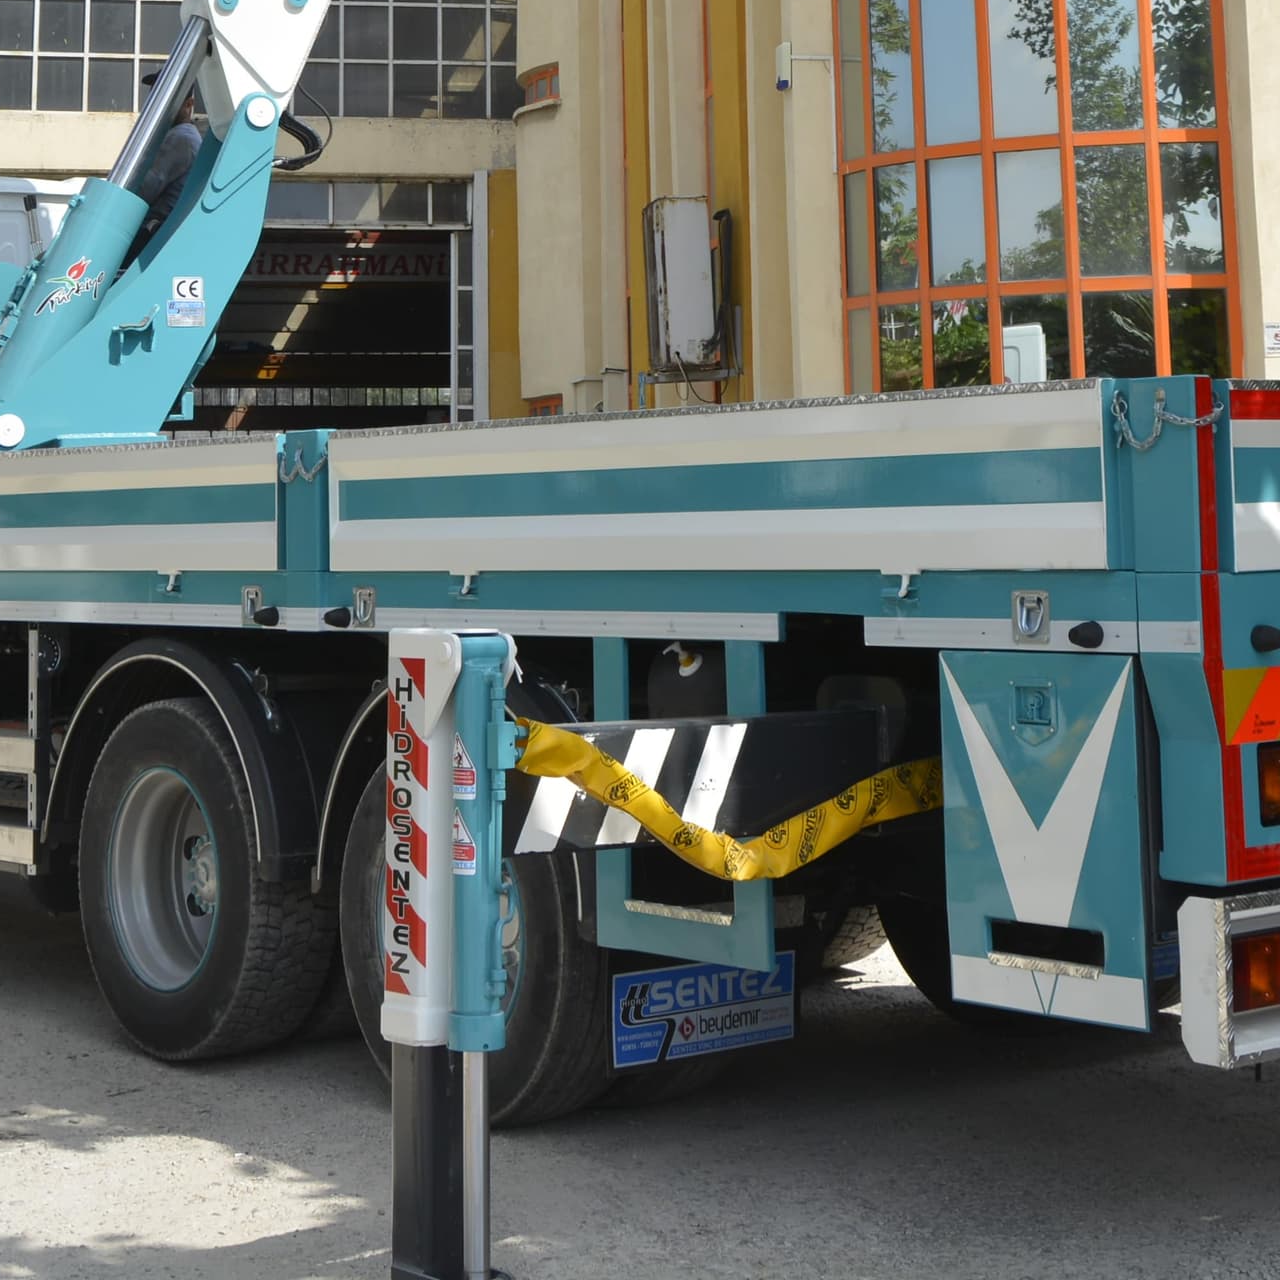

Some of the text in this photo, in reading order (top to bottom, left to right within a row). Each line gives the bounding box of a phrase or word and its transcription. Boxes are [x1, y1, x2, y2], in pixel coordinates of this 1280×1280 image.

[35, 271, 105, 315] Türkiye
[177, 280, 199, 297] CE
[649, 963, 783, 1013] SENTEZ
[699, 1008, 761, 1038] beydemir
